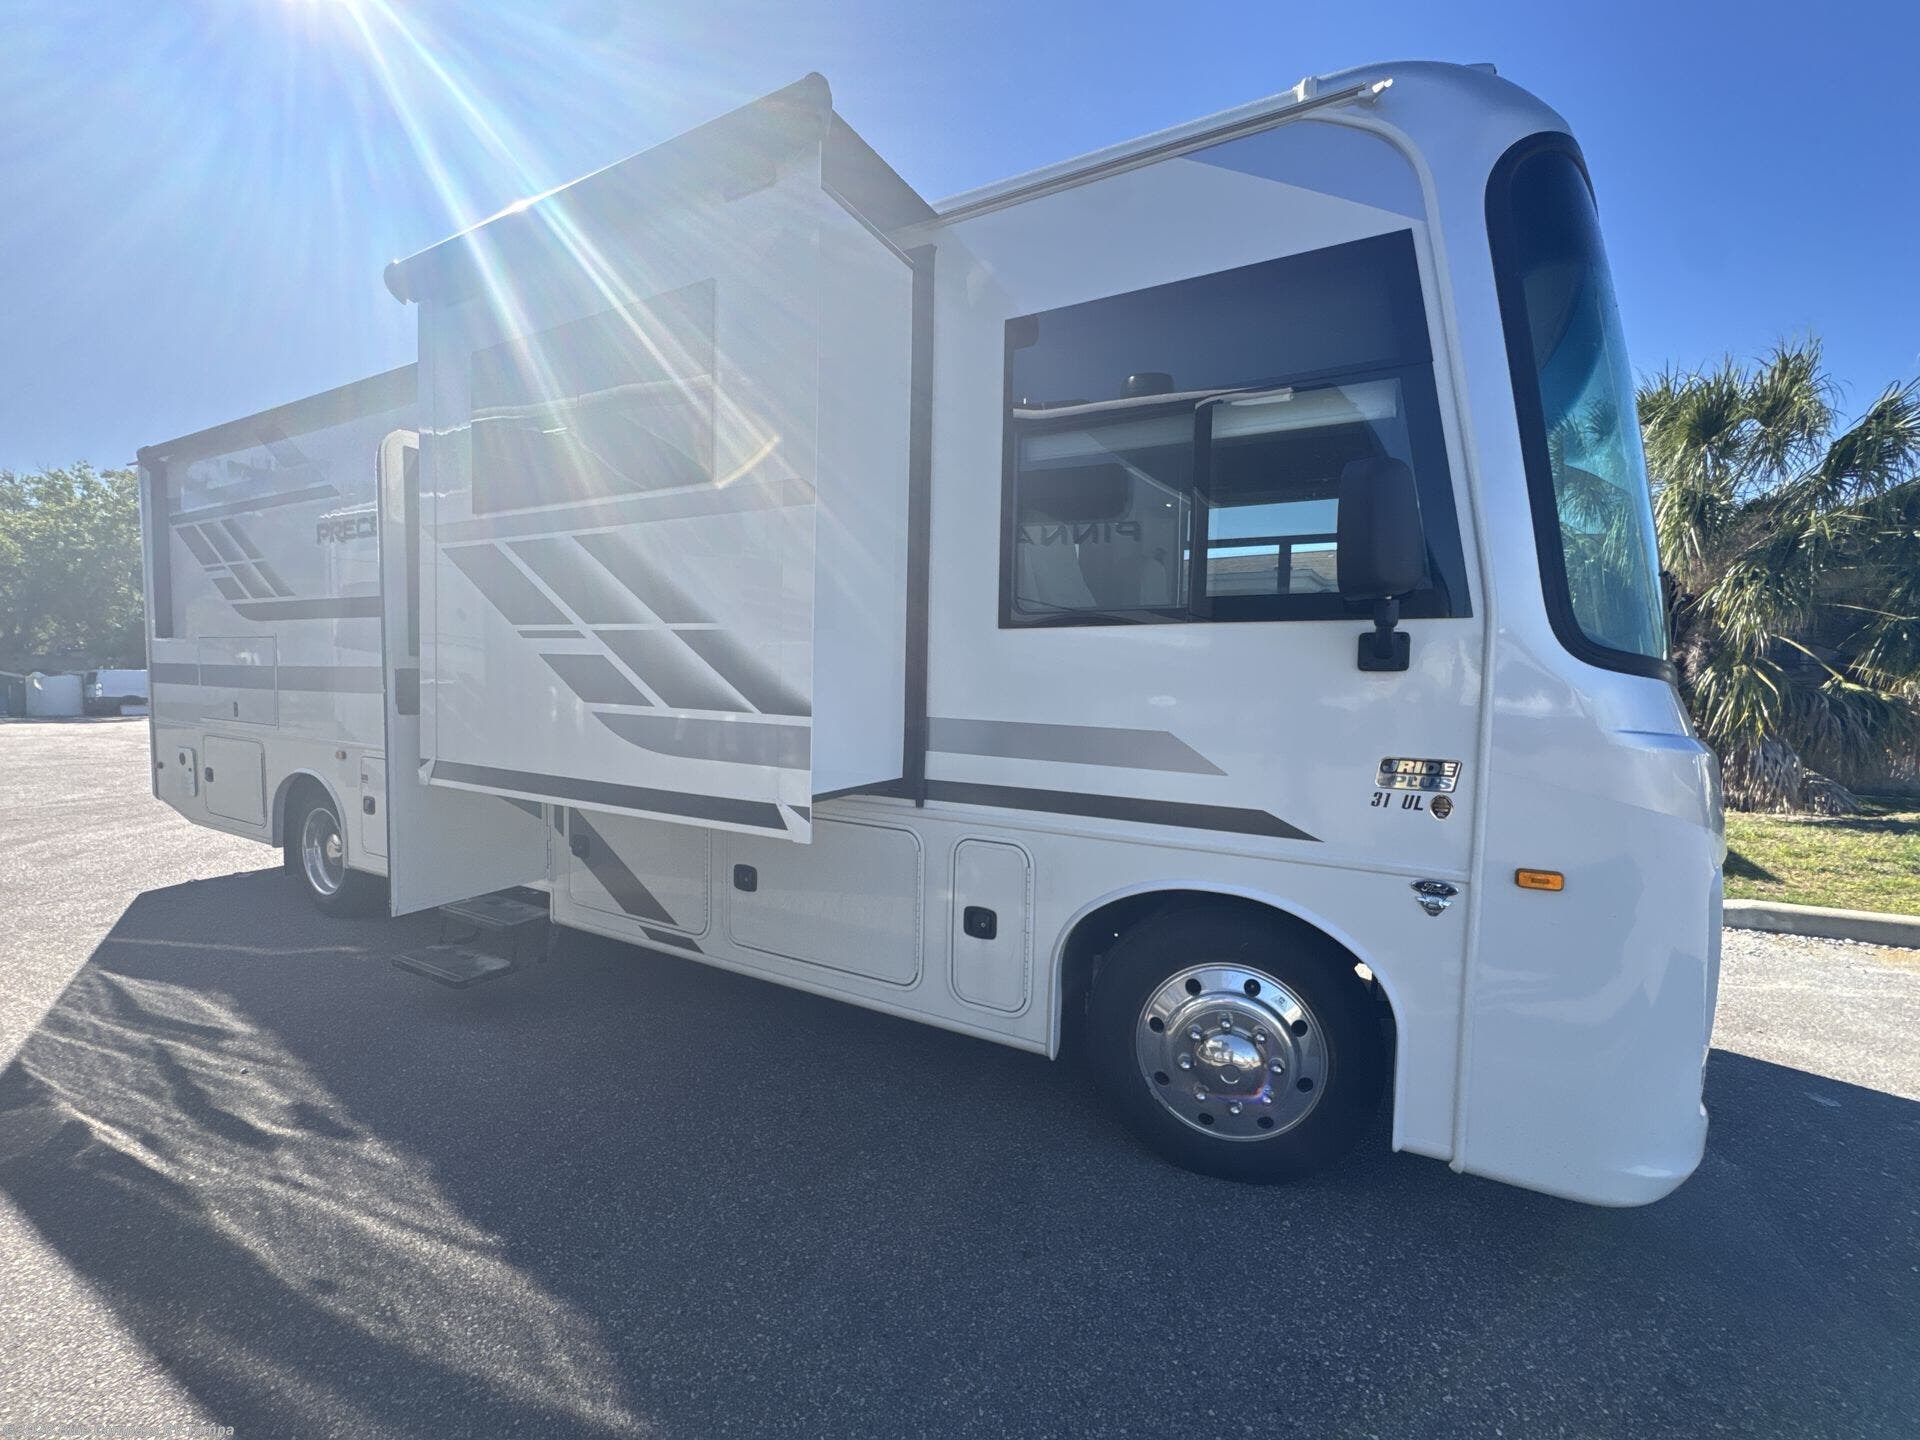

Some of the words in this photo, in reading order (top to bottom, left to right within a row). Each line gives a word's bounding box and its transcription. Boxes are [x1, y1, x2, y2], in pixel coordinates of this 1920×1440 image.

[1392, 775, 1453, 790] PLUS
[1371, 791, 1391, 808] 31
[1401, 794, 1424, 811] UL
[1420, 881, 1449, 895] Ford
